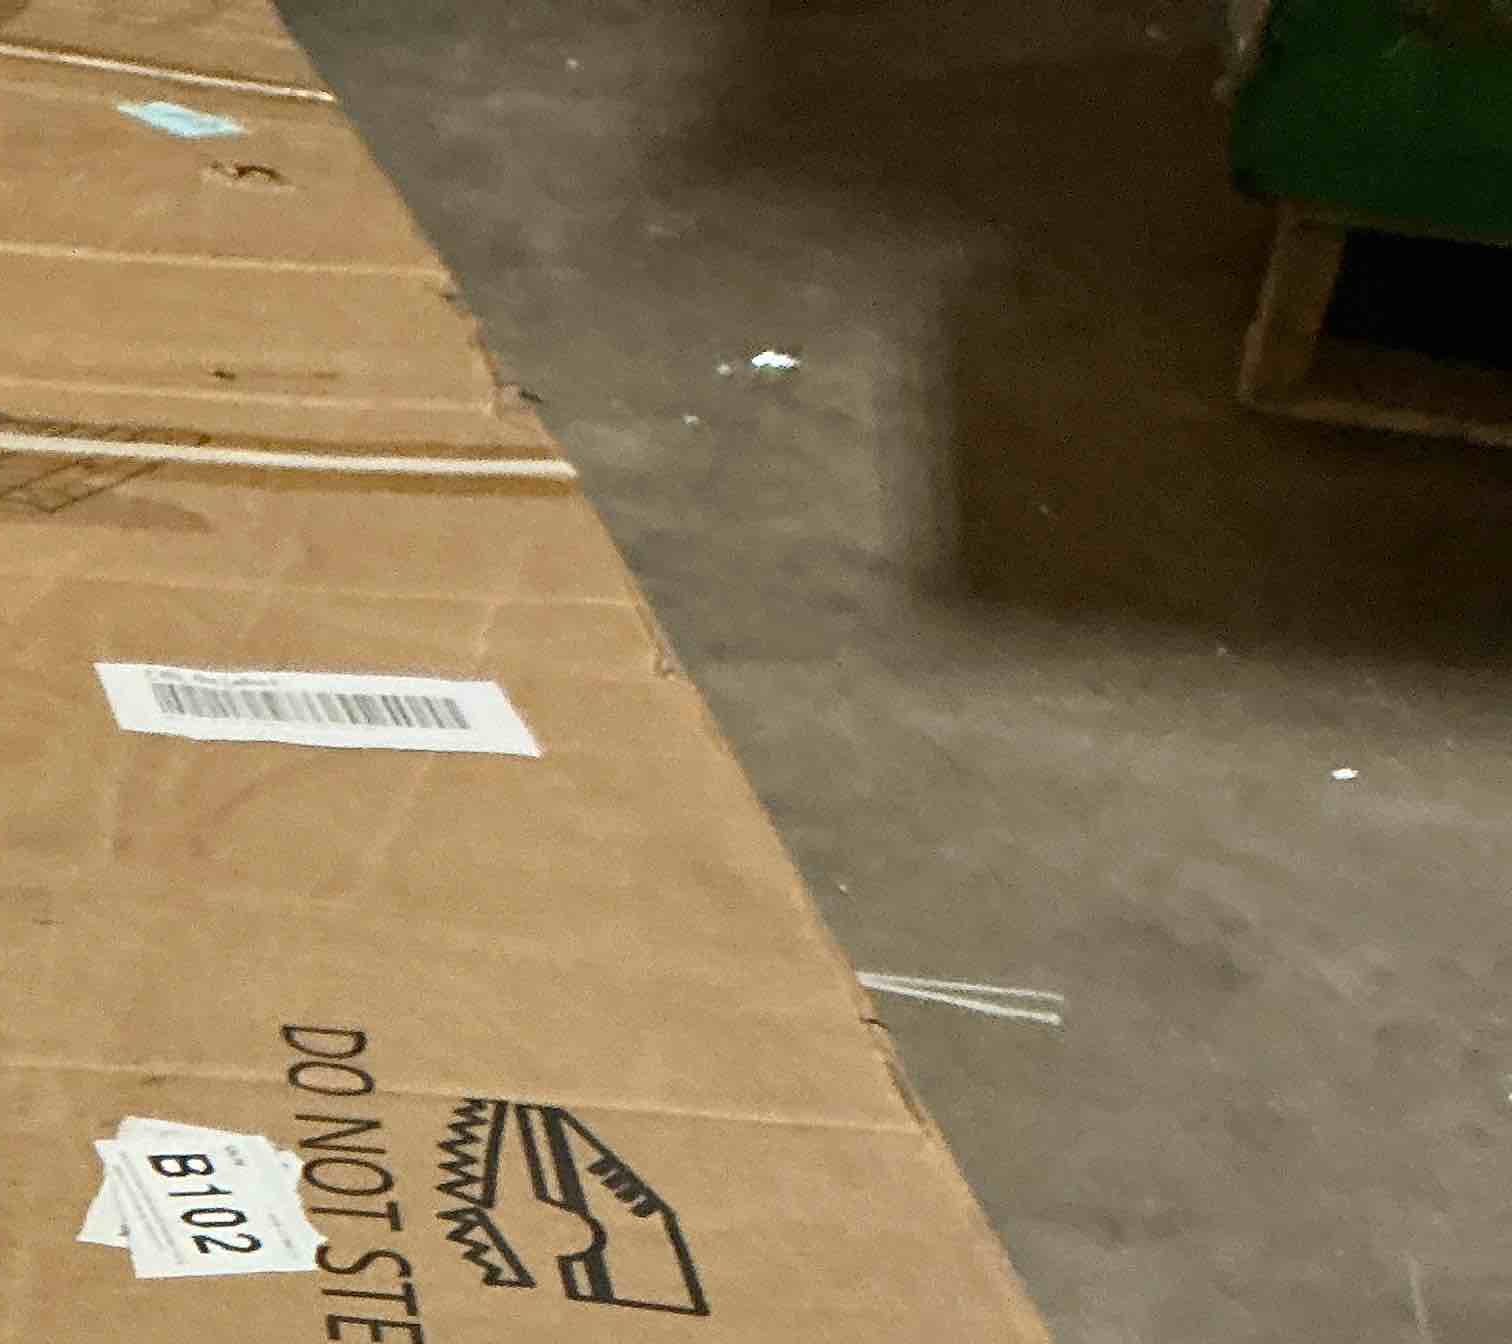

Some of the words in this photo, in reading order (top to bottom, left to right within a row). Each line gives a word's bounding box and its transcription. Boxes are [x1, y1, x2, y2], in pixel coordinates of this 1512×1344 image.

[280, 1022, 375, 1097] DO
[148, 1153, 264, 1255] B102
[294, 1112, 405, 1232] NOT
